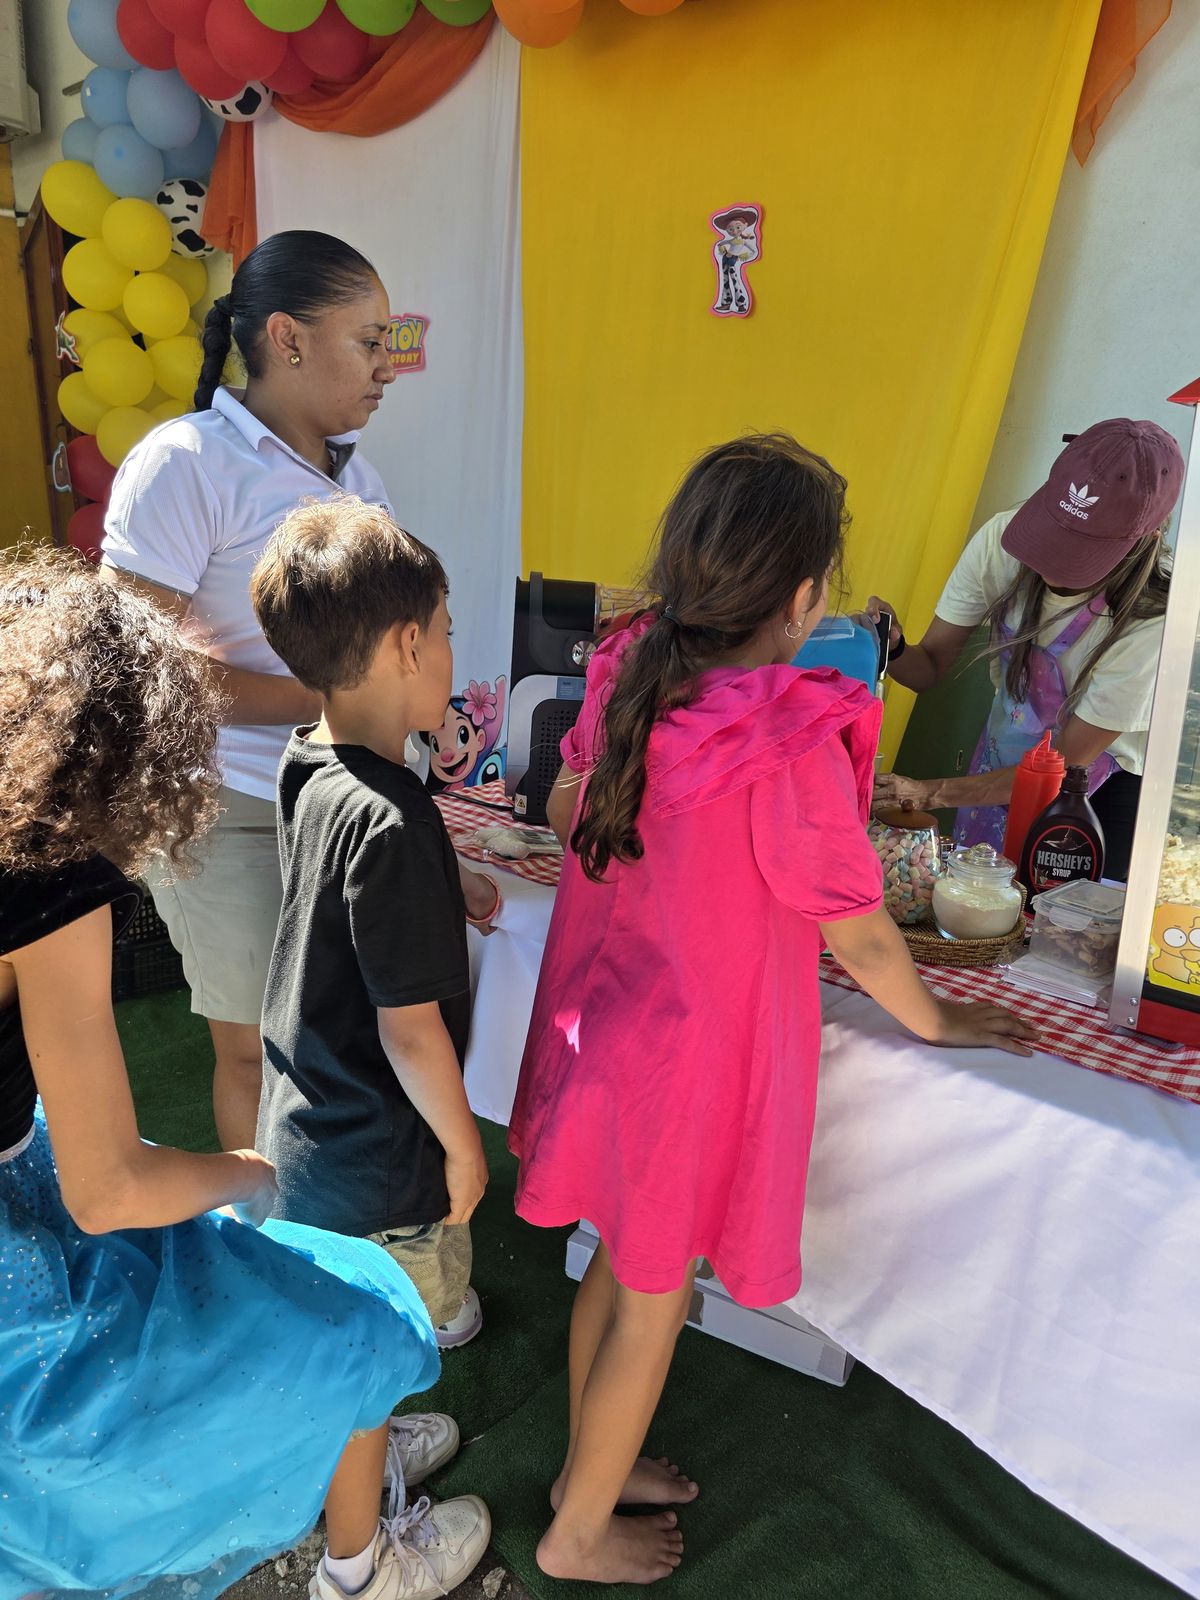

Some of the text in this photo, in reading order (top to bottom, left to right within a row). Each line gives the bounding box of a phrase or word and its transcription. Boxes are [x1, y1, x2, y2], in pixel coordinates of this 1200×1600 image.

[390, 319, 423, 351] TOY
[390, 353, 419, 364] STORY
[1059, 500, 1089, 520] adidas
[1037, 850, 1092, 871] HERSHEY'S
[1052, 867, 1072, 878] SYRUP
